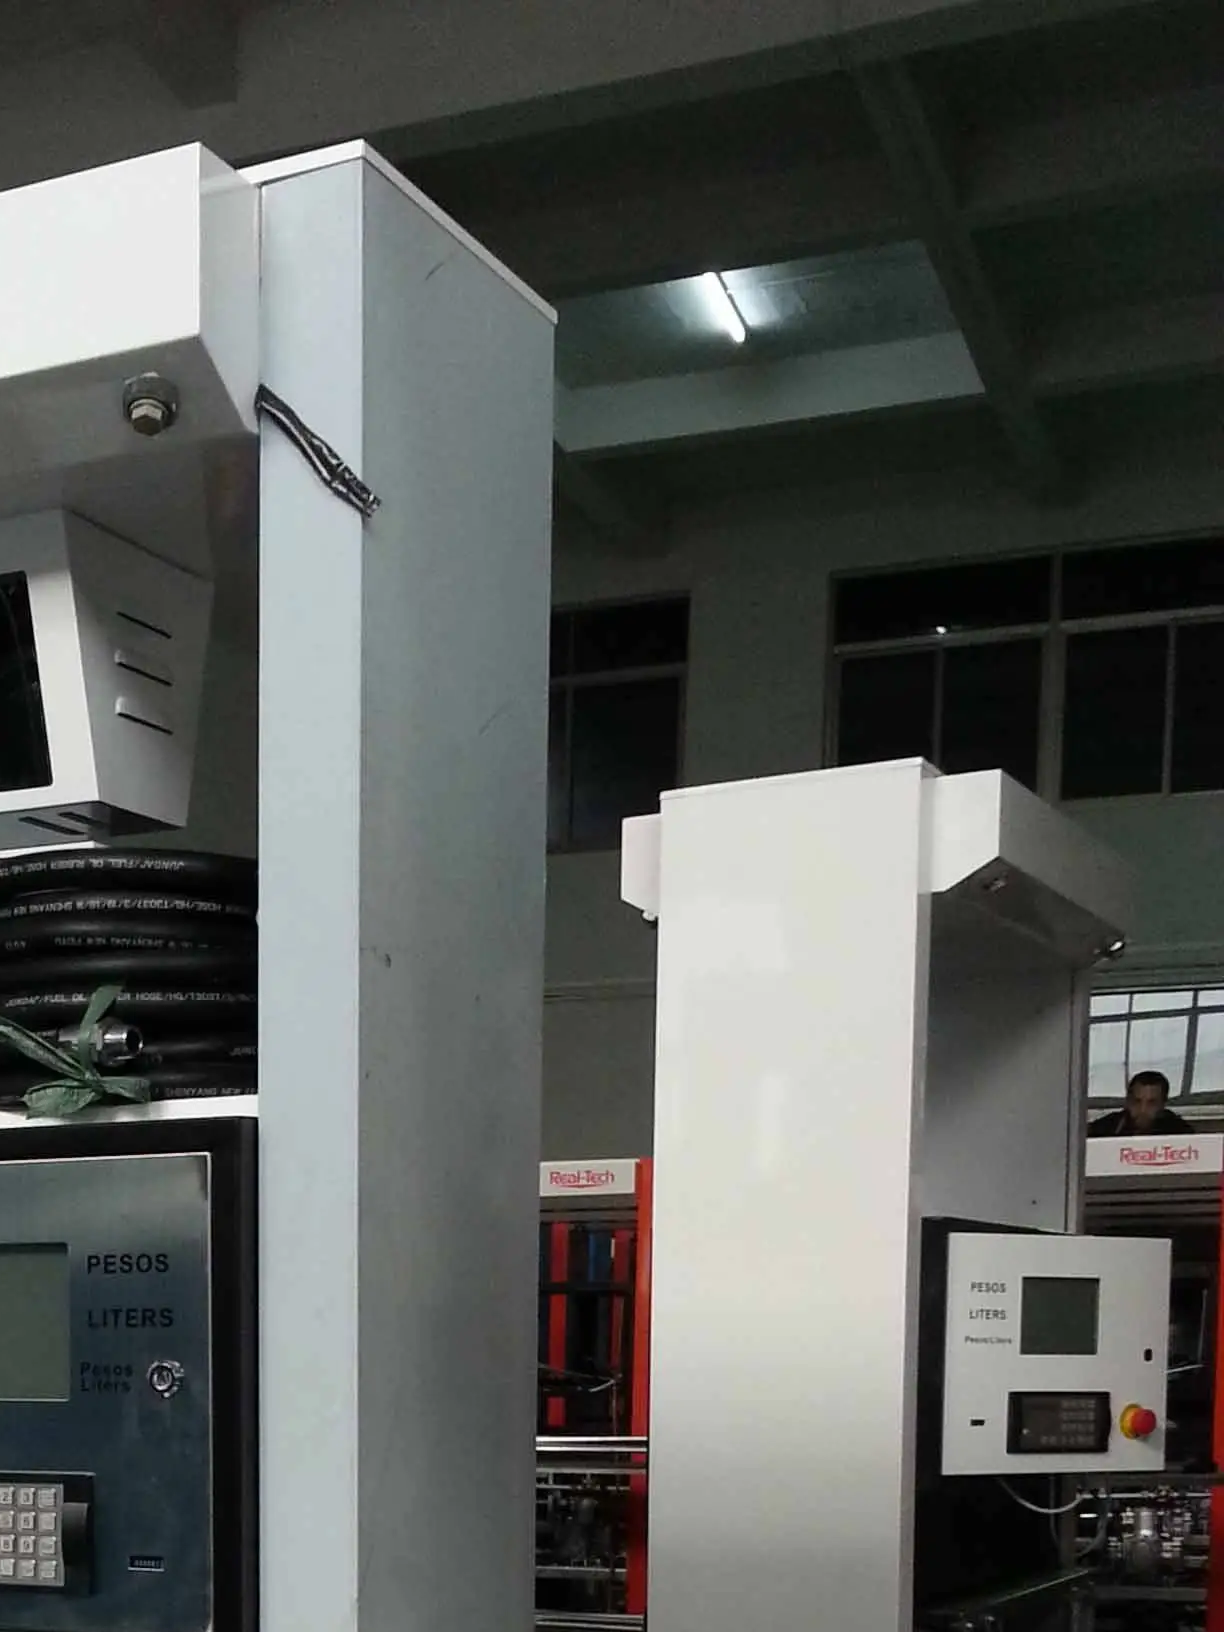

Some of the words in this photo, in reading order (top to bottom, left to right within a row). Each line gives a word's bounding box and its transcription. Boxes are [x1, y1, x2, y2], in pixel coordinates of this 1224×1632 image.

[1120, 1144, 1200, 1164] Real-Tech
[550, 1169, 615, 1186] Real-Tech
[86, 1253, 171, 1276] PESOS
[970, 1280, 1007, 1294] PESOS
[87, 1308, 175, 1329] LITERS
[968, 1307, 1007, 1321] LITERS
[80, 1361, 134, 1377] Pesos
[80, 1377, 132, 1393] Liters
